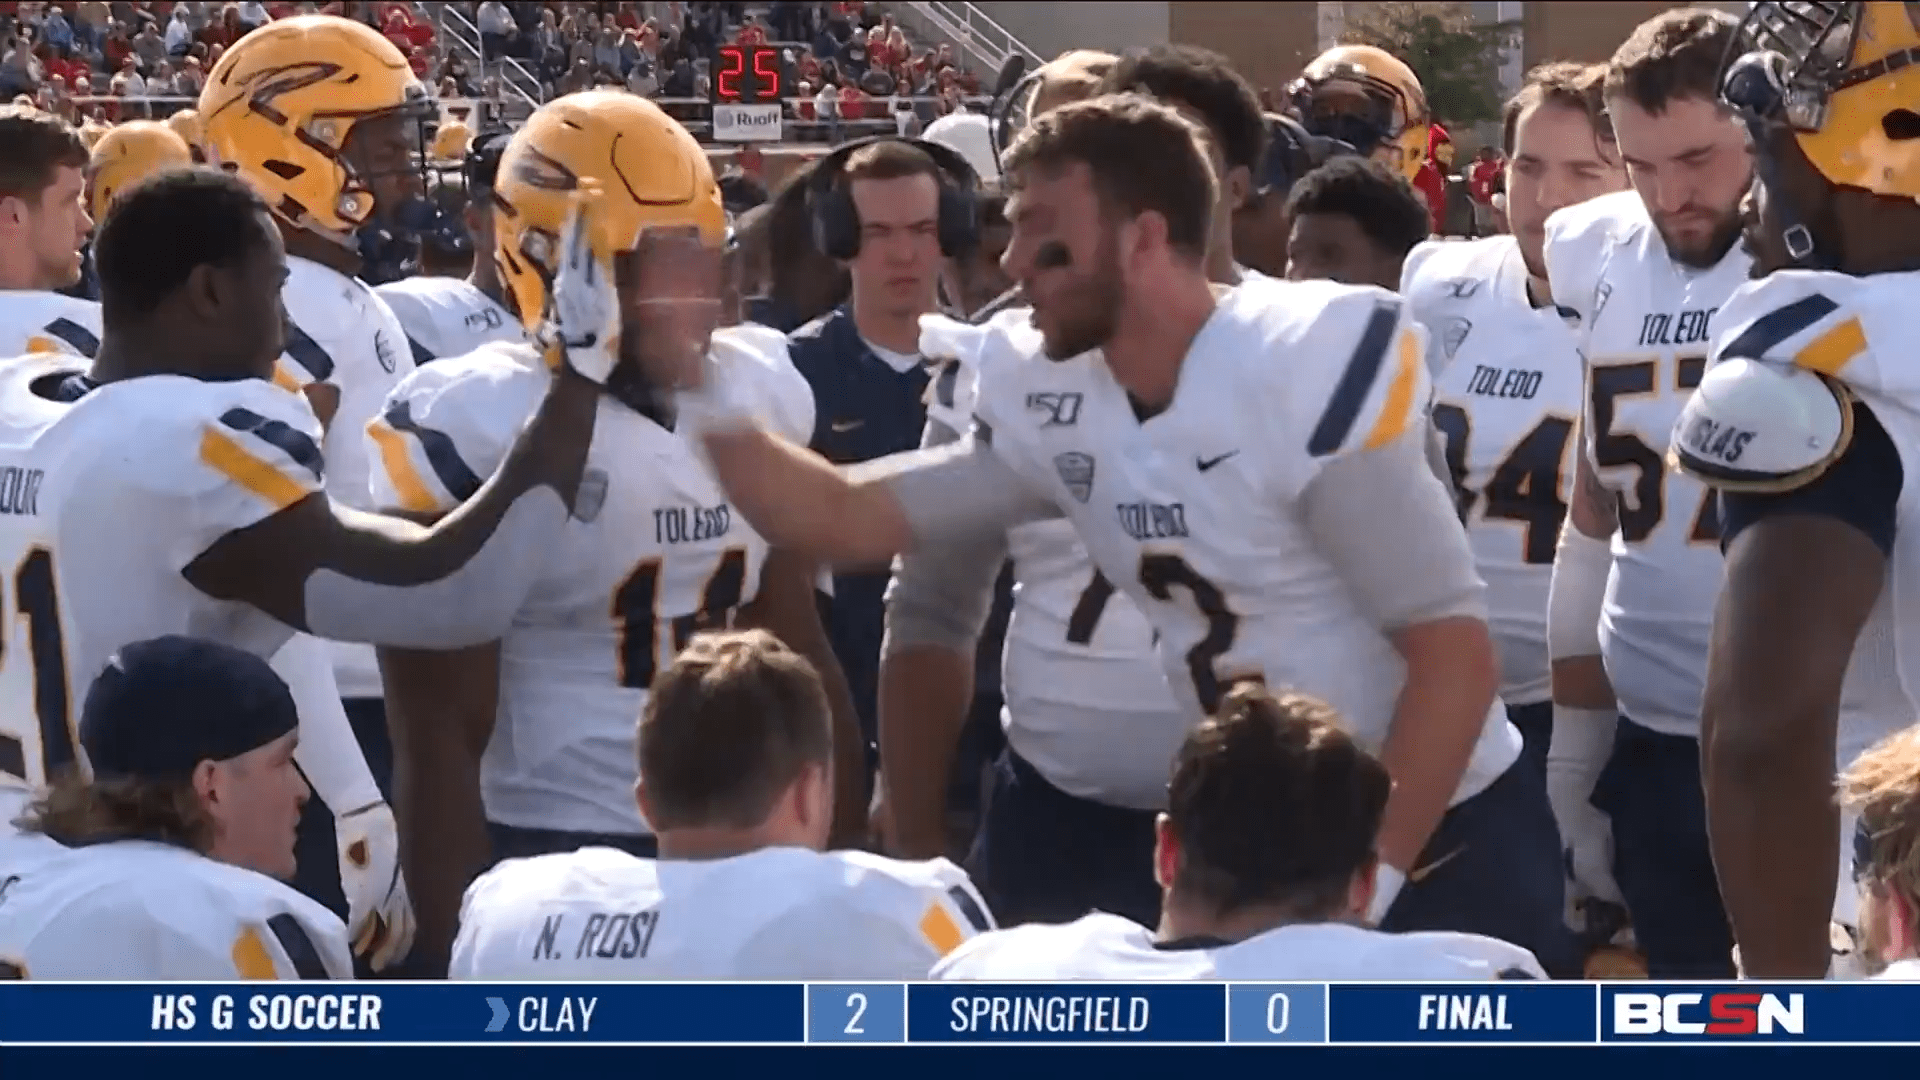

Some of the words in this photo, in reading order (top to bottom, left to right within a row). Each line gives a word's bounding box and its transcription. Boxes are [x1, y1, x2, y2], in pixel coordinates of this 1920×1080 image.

[718, 49, 778, 96] 25
[1639, 307, 1719, 345] TOLEDO
[1466, 364, 1543, 400] TOLEDO
[653, 504, 730, 544] TOLEDO
[1135, 547, 1265, 718] 2
[532, 914, 562, 960] N.
[575, 910, 660, 960] ROSI
